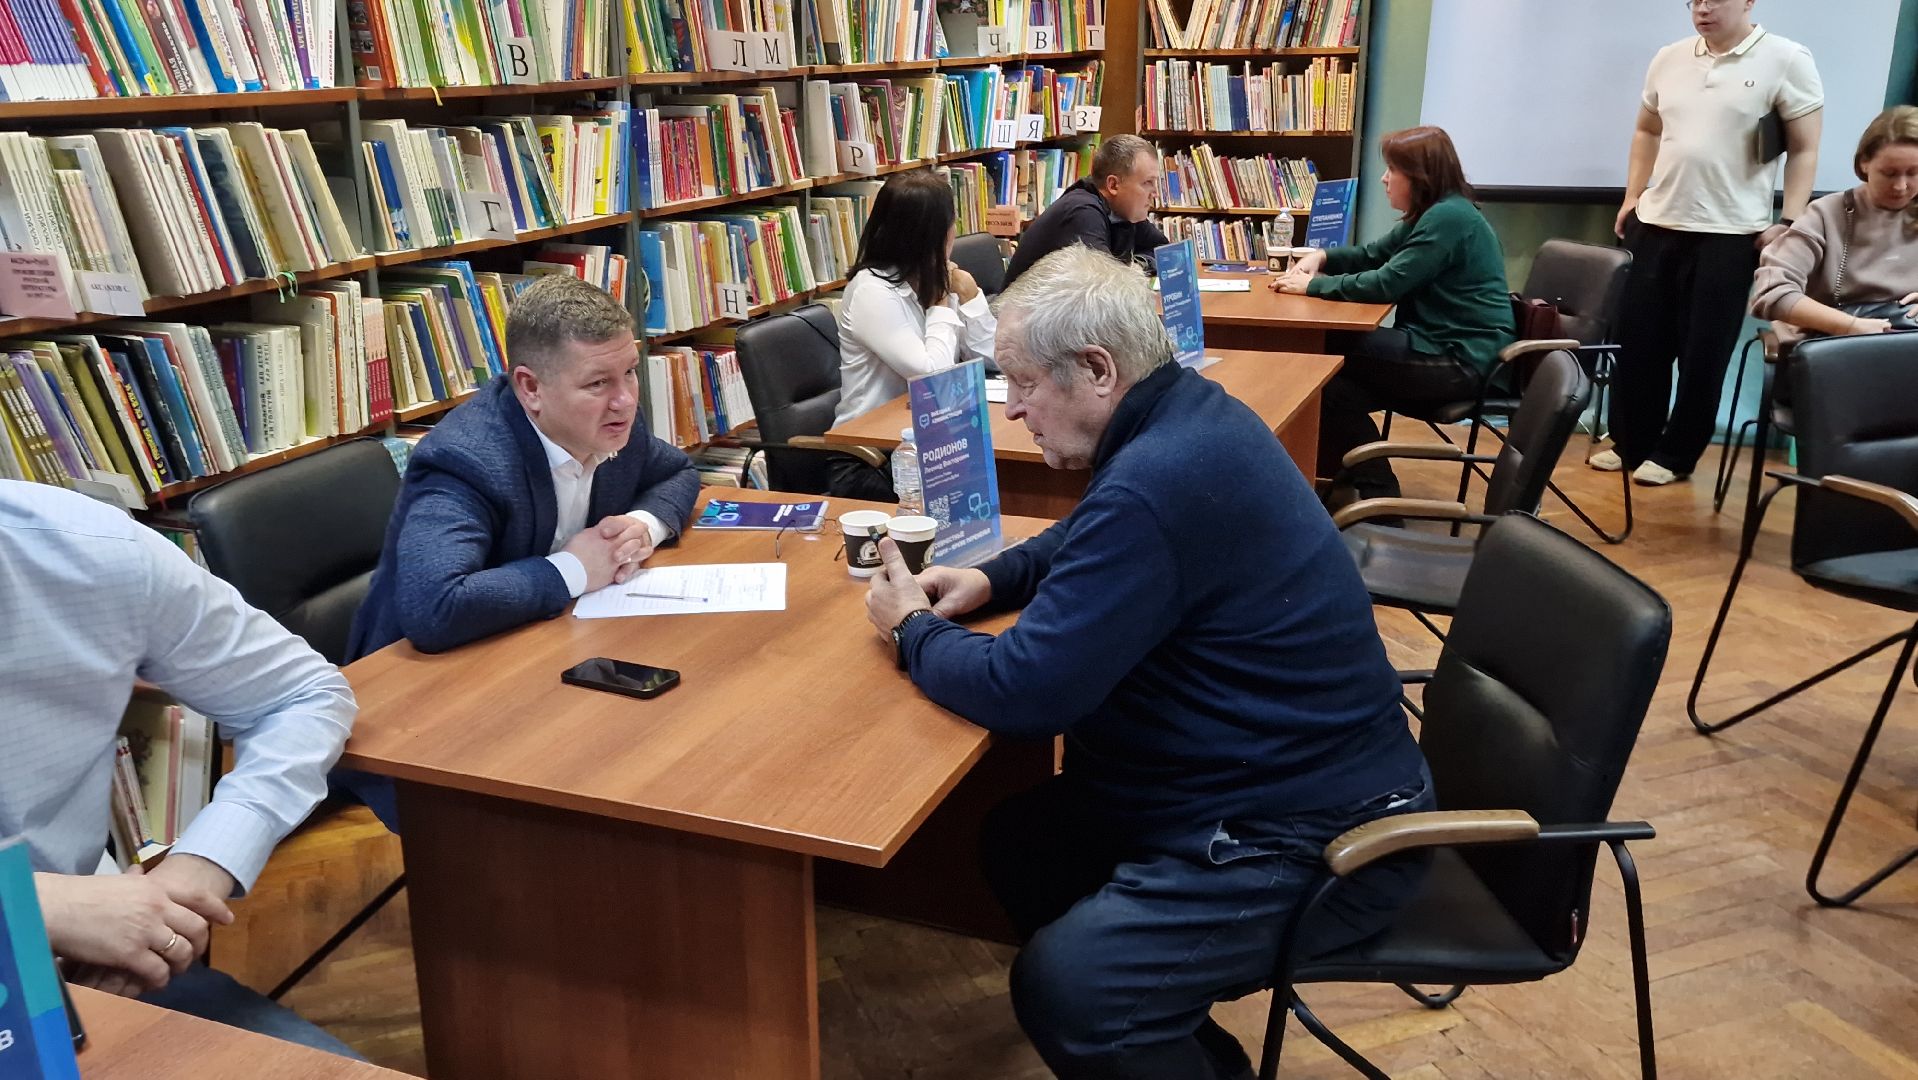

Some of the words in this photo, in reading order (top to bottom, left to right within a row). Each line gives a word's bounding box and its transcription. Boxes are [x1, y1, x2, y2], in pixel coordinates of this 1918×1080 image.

[989, 33, 1001, 53] Ч
[1035, 31, 1048, 49] В
[1088, 29, 1100, 47] Г
[507, 44, 530, 77] В
[732, 39, 747, 68] Л
[764, 38, 782, 65] М
[998, 124, 1011, 143] Ш
[1027, 120, 1040, 138] Я
[848, 145, 864, 167] Р
[480, 200, 501, 232] Г
[723, 288, 740, 314] Н
[922, 437, 968, 464] РОДИОНОВ
